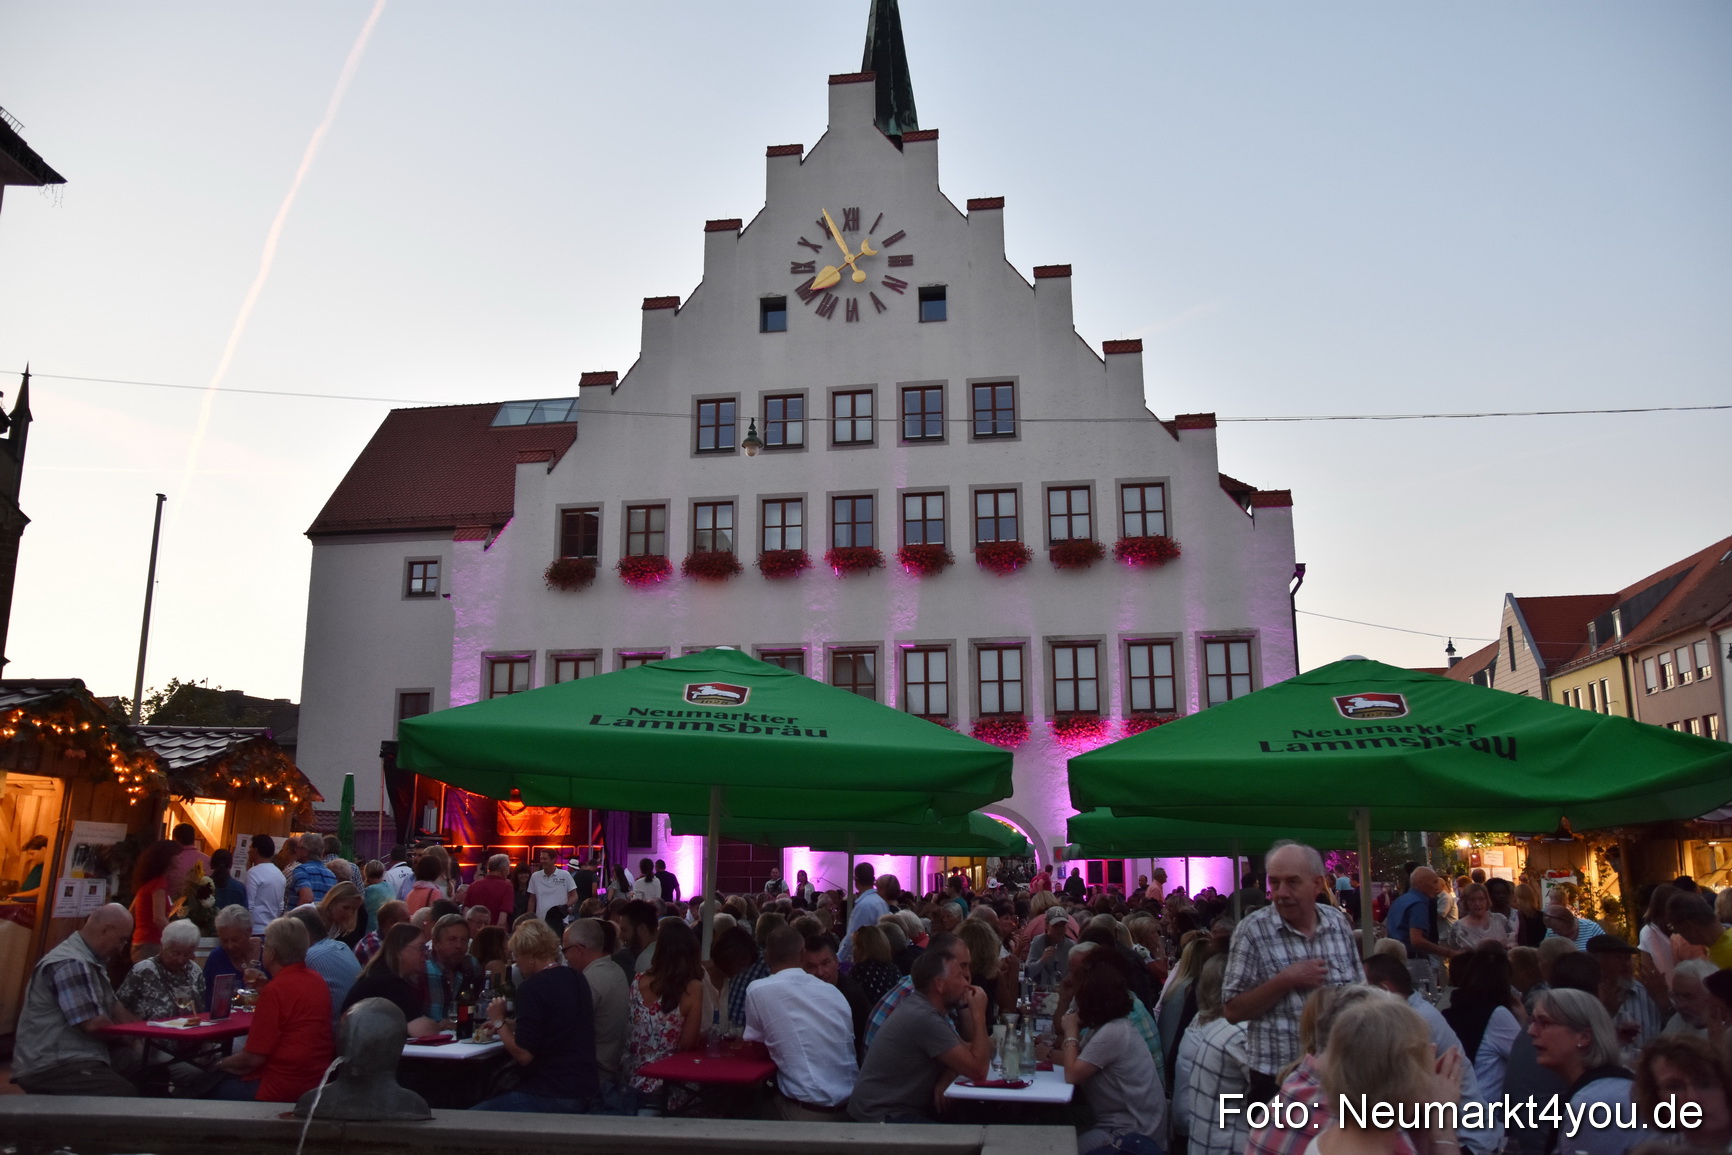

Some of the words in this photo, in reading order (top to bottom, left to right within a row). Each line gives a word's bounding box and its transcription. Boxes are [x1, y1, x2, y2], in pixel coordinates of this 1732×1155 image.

[842, 207, 860, 232] XII
[797, 235, 823, 254] X
[589, 714, 829, 738] Lammsbräu
[628, 707, 798, 725] Neumarkter
